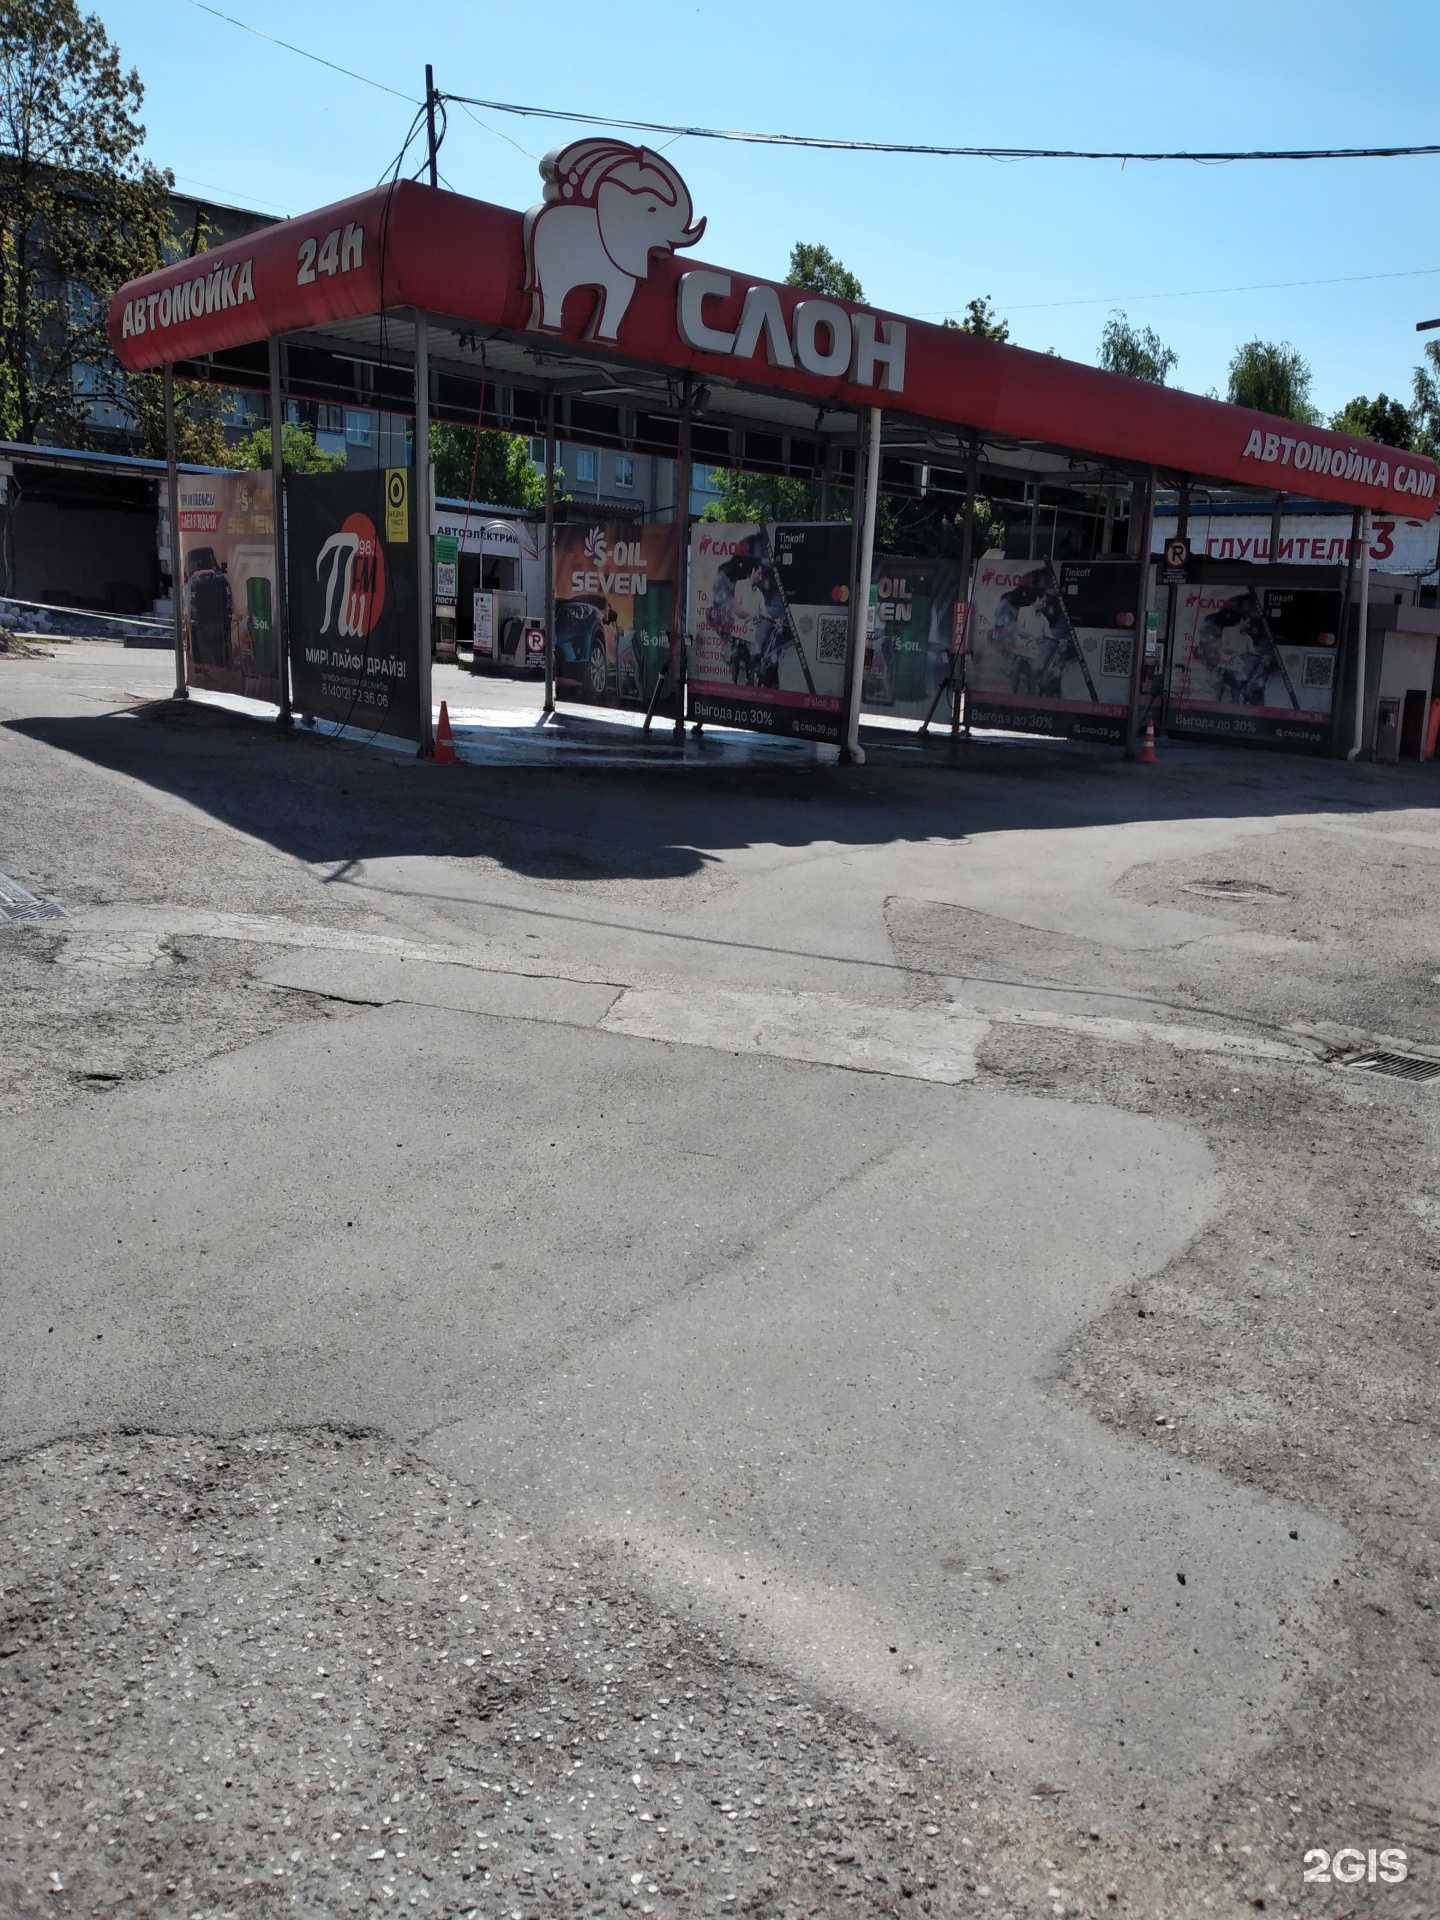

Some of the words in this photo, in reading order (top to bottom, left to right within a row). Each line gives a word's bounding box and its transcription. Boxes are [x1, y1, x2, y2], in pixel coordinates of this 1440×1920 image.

[122, 257, 256, 339] АВТОМОЙКА
[296, 222, 365, 286] 24h
[677, 270, 907, 392] СЛОН
[1242, 429, 1389, 488] АВТОМОЙКА
[1393, 465, 1436, 498] САМ
[593, 540, 648, 567] S-OIL
[571, 571, 647, 595] SEVEN
[305, 647, 329, 664] МИР!
[331, 648, 363, 670] ЛАЙФ!
[367, 655, 406, 678] ДРАЙВ!
[694, 701, 733, 721] Выгода
[734, 707, 748, 722] до
[750, 708, 773, 726] 30%
[971, 708, 1011, 723] Выгода
